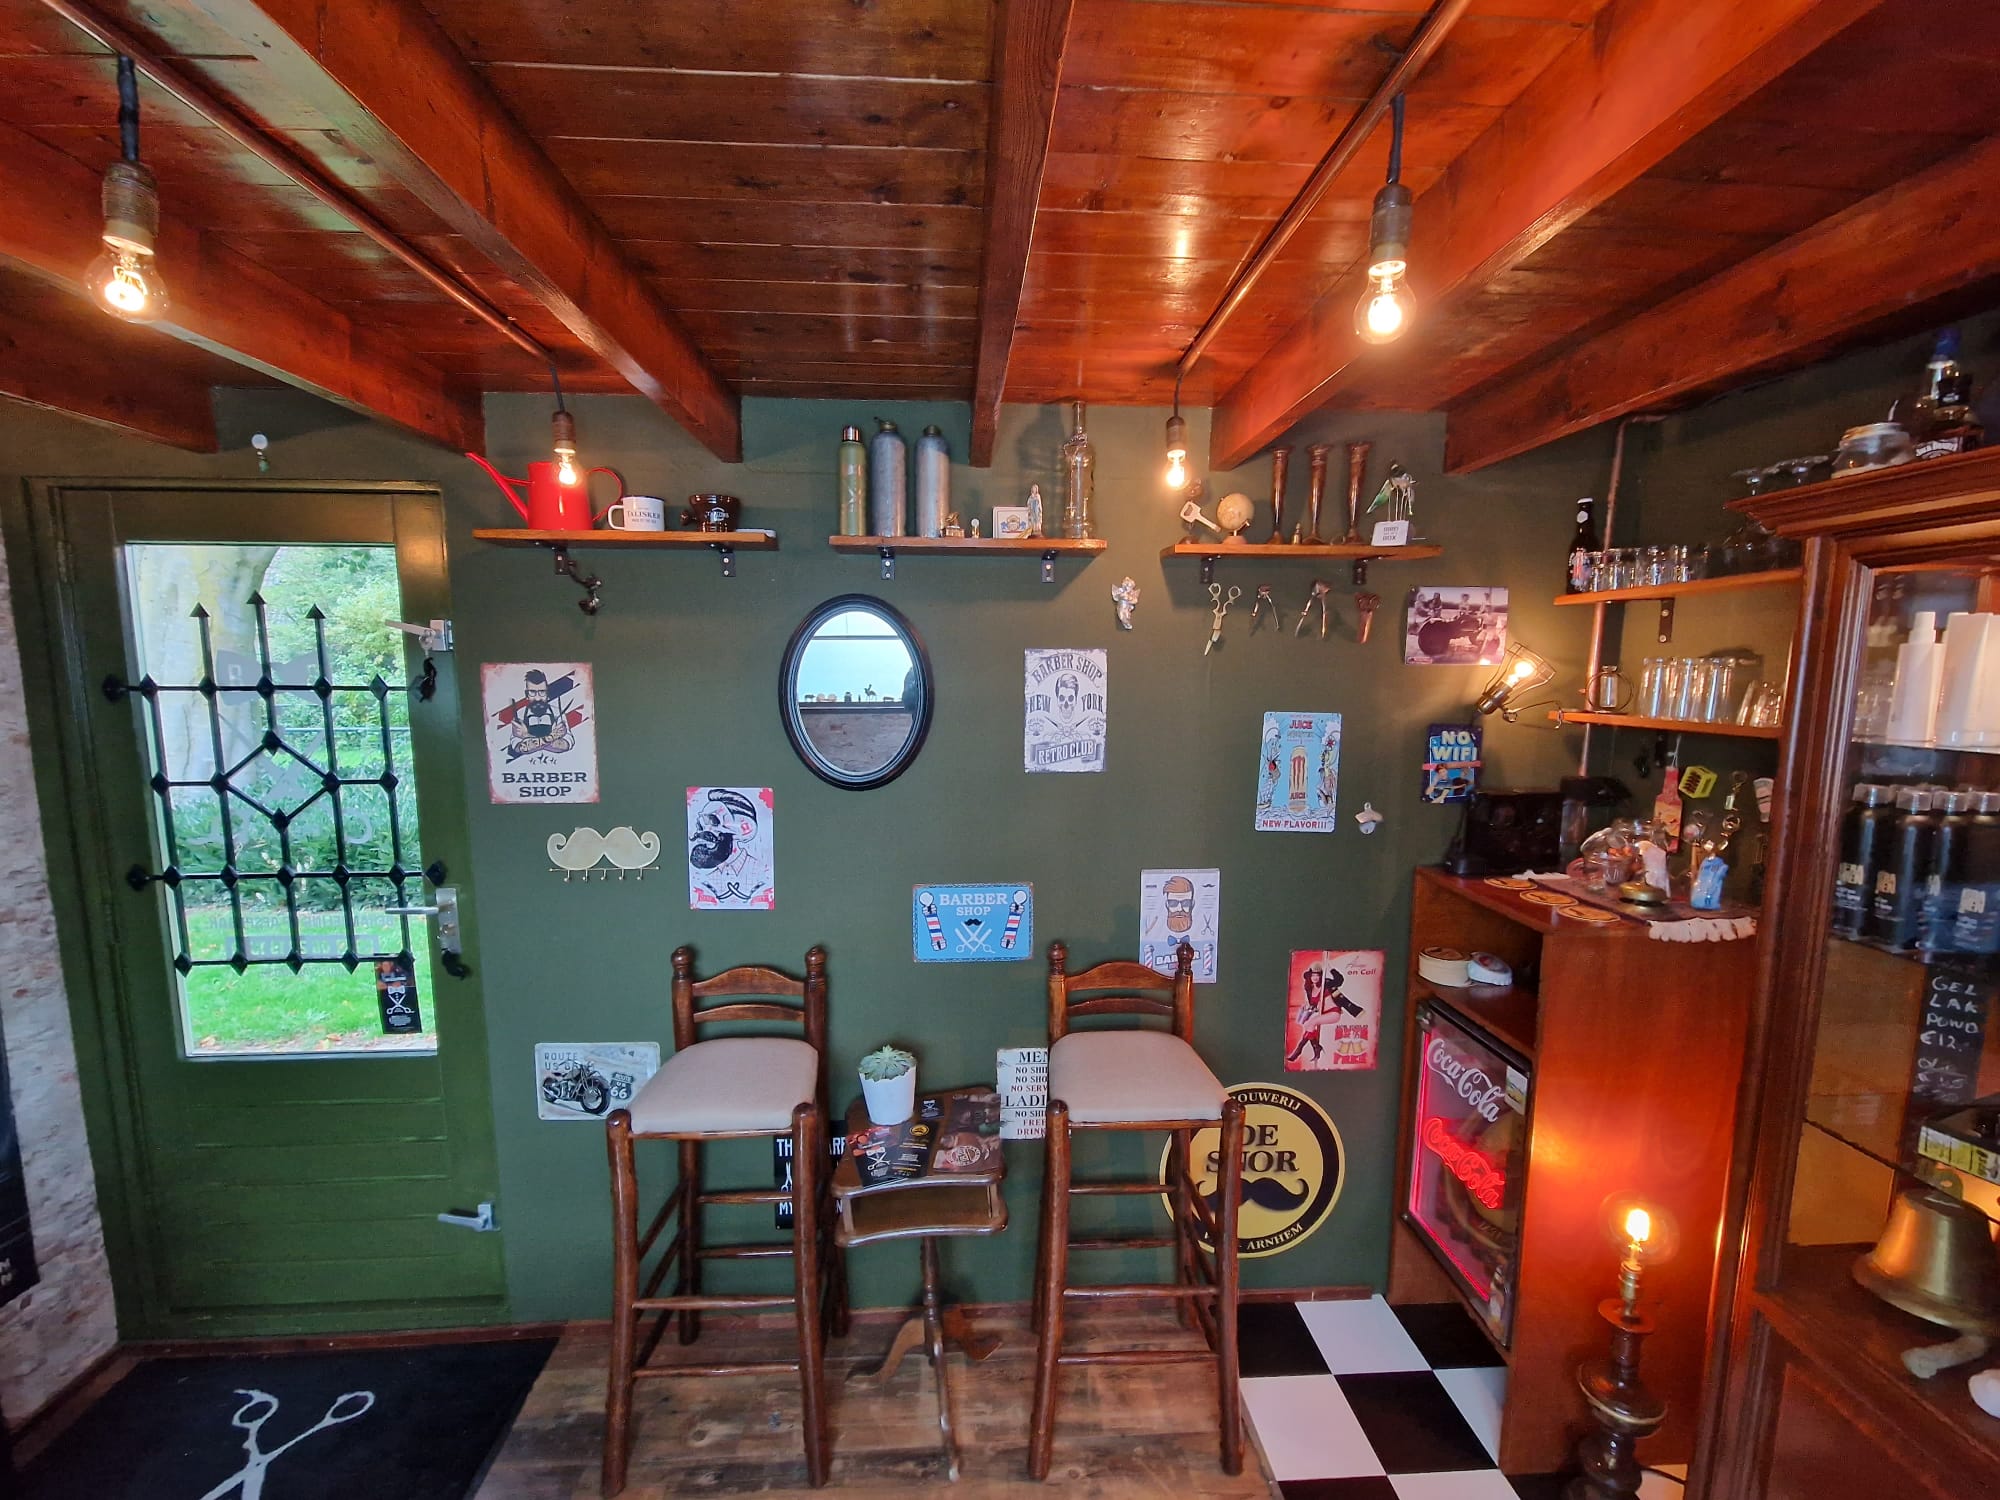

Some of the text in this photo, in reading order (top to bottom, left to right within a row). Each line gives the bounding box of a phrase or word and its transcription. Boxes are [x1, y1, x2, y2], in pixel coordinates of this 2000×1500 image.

[627, 510, 660, 520] TALISKER
[1031, 654, 1103, 685] BARBER SHOP
[1029, 693, 1104, 714] NEW YORK
[1441, 730, 1472, 746] NO
[1038, 740, 1095, 765] RETRO CLUB
[1432, 746, 1478, 761] WIFI
[502, 772, 588, 784] BARBER
[519, 786, 572, 798] SHOP
[1262, 819, 1282, 828] NEW
[939, 893, 1009, 906] BARBER
[956, 906, 991, 917] SHOP
[1932, 976, 1976, 996] GEL
[1929, 993, 1978, 1014] LAK
[544, 1052, 579, 1061] ROUTE
[1427, 1038, 1506, 1123] Coca-Cola
[610, 1086, 628, 1099] 66
[1011, 1085, 1023, 1093] NO
[1231, 1091, 1301, 1112] OUWERIJ
[1014, 1110, 1027, 1118] NO
[1206, 1150, 1300, 1173] SOR
[1423, 1117, 1506, 1210] Coca-Cola
[1246, 1224, 1303, 1250] ARNHEM
